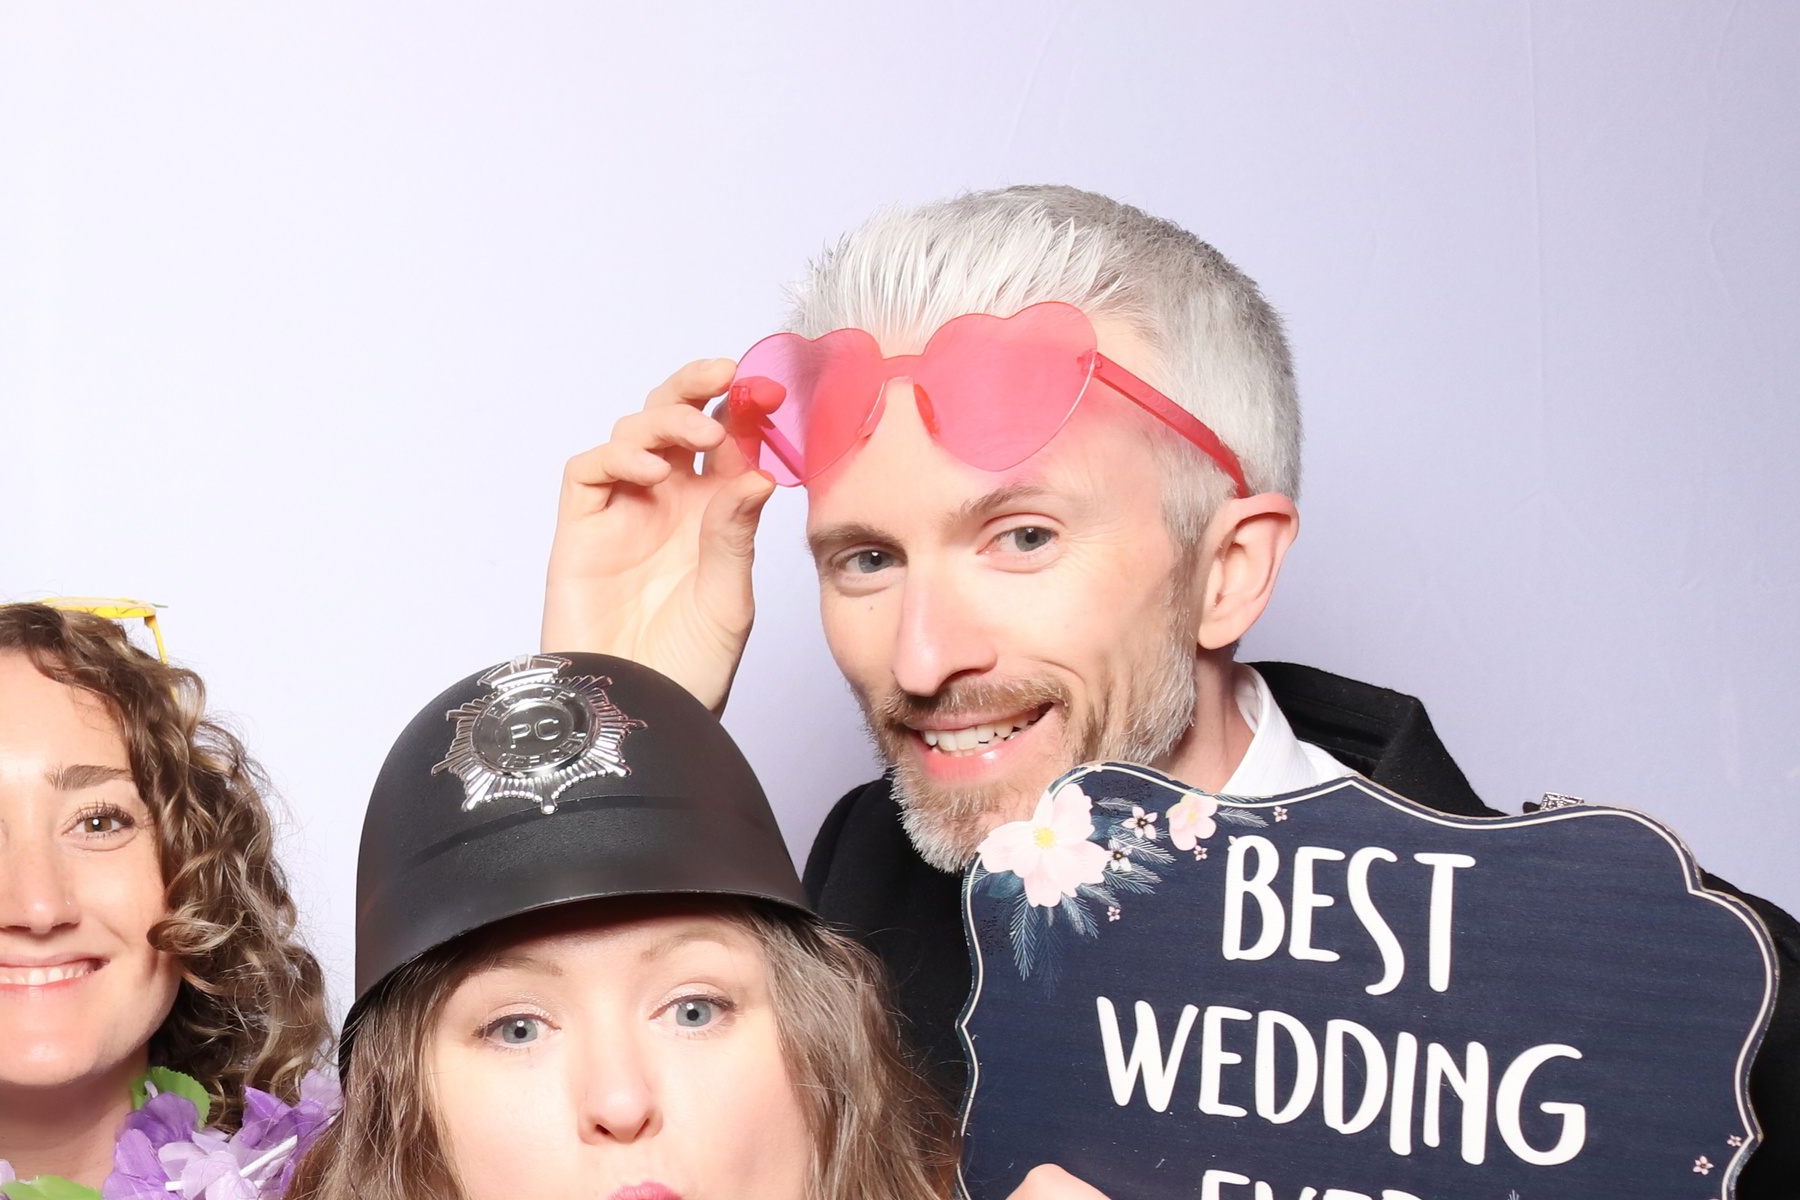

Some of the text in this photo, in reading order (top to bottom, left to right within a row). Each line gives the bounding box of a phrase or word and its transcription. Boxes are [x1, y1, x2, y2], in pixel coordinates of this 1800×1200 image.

[509, 718, 560, 749] PC
[1222, 834, 1476, 996] BEST
[1096, 996, 1587, 1166] WEDDING
